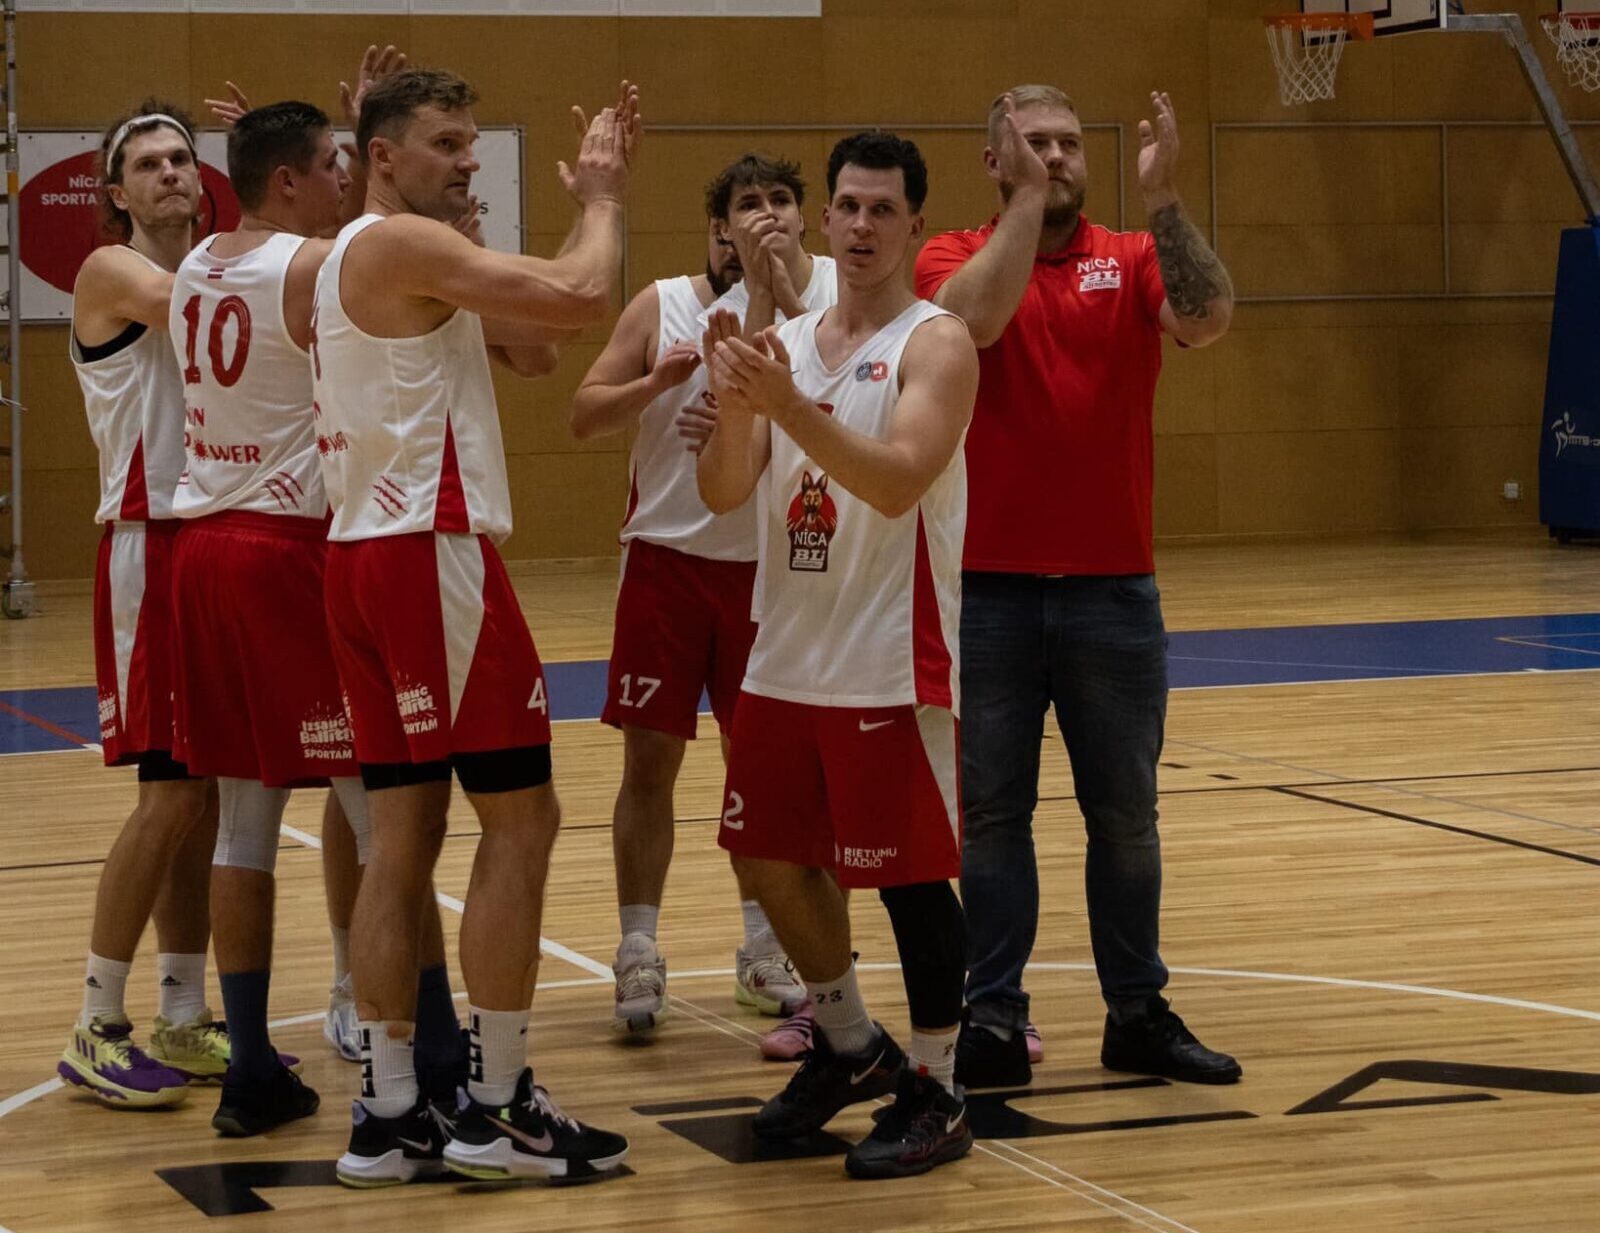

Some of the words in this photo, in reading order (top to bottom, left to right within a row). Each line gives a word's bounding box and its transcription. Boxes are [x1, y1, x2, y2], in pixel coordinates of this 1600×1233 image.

[41, 192, 97, 206] SPORTA
[182, 294, 252, 388] 10
[527, 677, 547, 716] 4
[618, 673, 661, 709] 17
[303, 748, 353, 760] SPORTAM
[723, 790, 745, 831] 2
[844, 846, 898, 859] RIETUMU
[844, 856, 883, 869] RADIO
